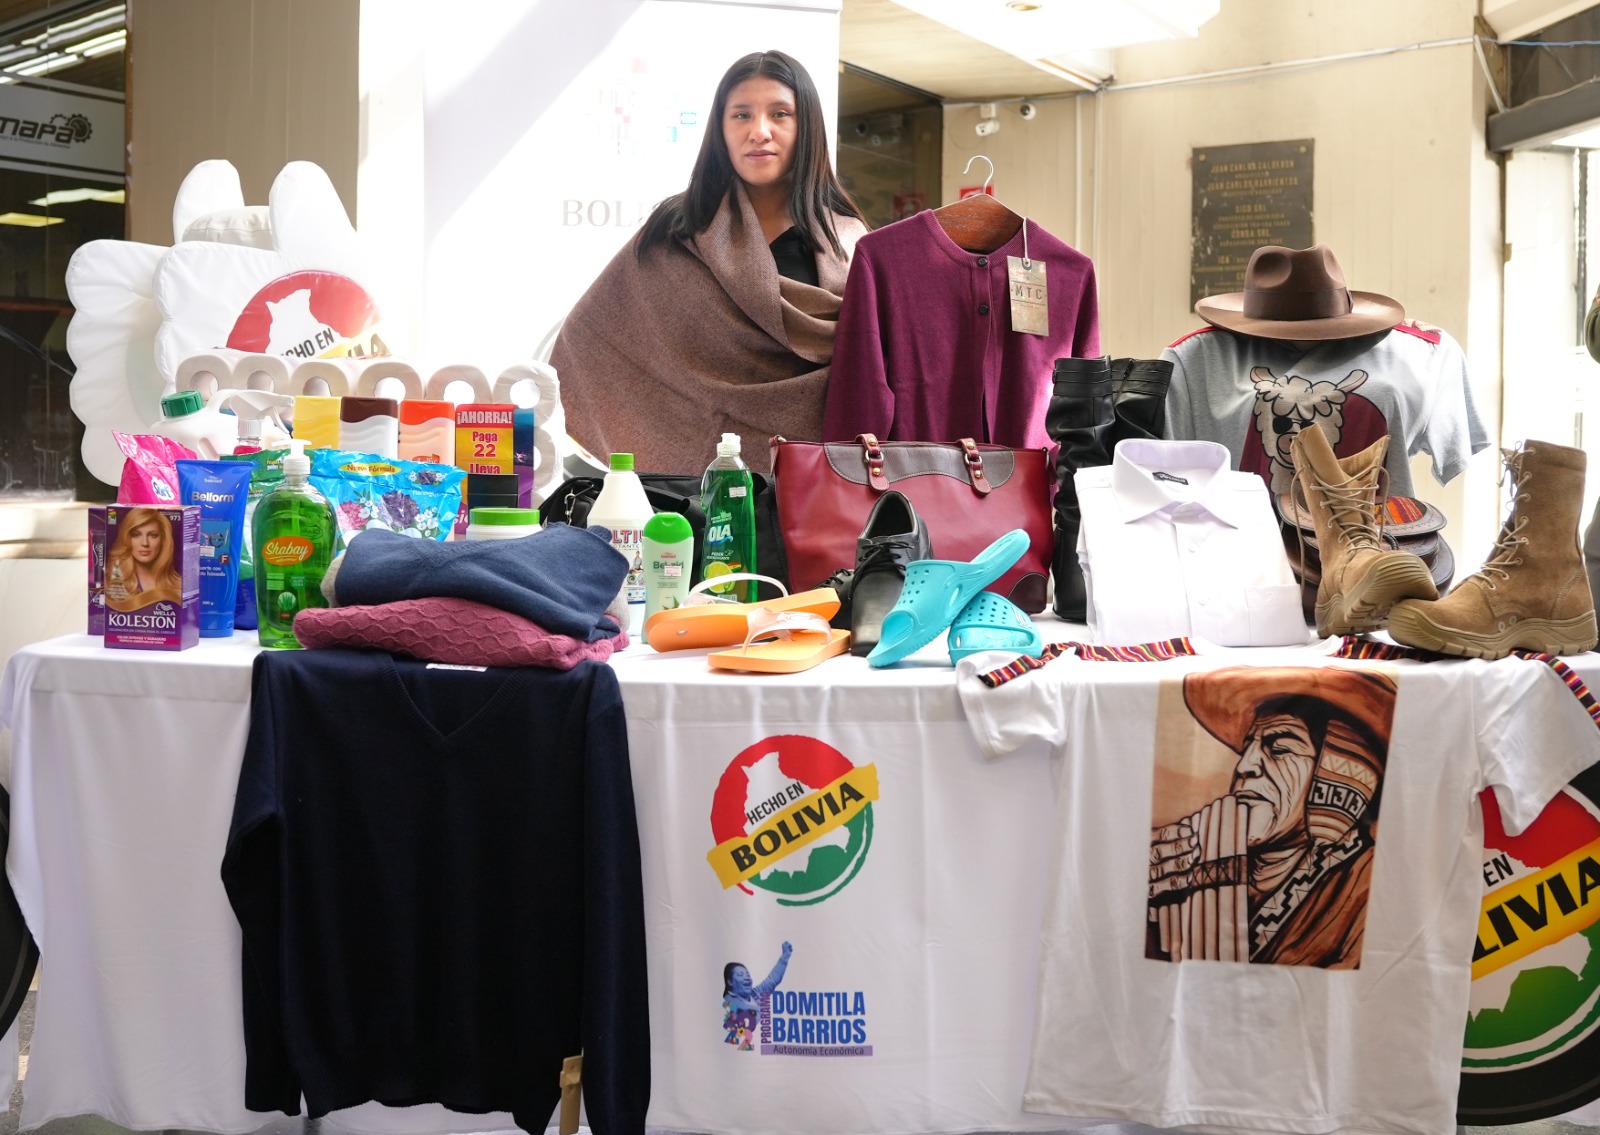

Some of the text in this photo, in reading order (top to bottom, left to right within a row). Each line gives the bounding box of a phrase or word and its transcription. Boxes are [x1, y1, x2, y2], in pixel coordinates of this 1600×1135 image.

[316, 328, 335, 350] EN
[457, 411, 512, 424] ¡AHORRA!
[472, 431, 498, 443] Paga
[474, 444, 496, 457] 22
[191, 492, 235, 502] Belform
[708, 524, 731, 542] OLA
[265, 542, 308, 560] Shabay
[109, 614, 176, 629] KOLESTON
[746, 781, 805, 826] HECHO EN
[730, 781, 865, 873] BOLIVIA
[1483, 853, 1514, 887] EN
[772, 990, 866, 1016] DOMITILA
[760, 991, 772, 1044] PROGRAMA
[772, 1018, 867, 1044] BARRIOS
[819, 1046, 864, 1056] Económica
